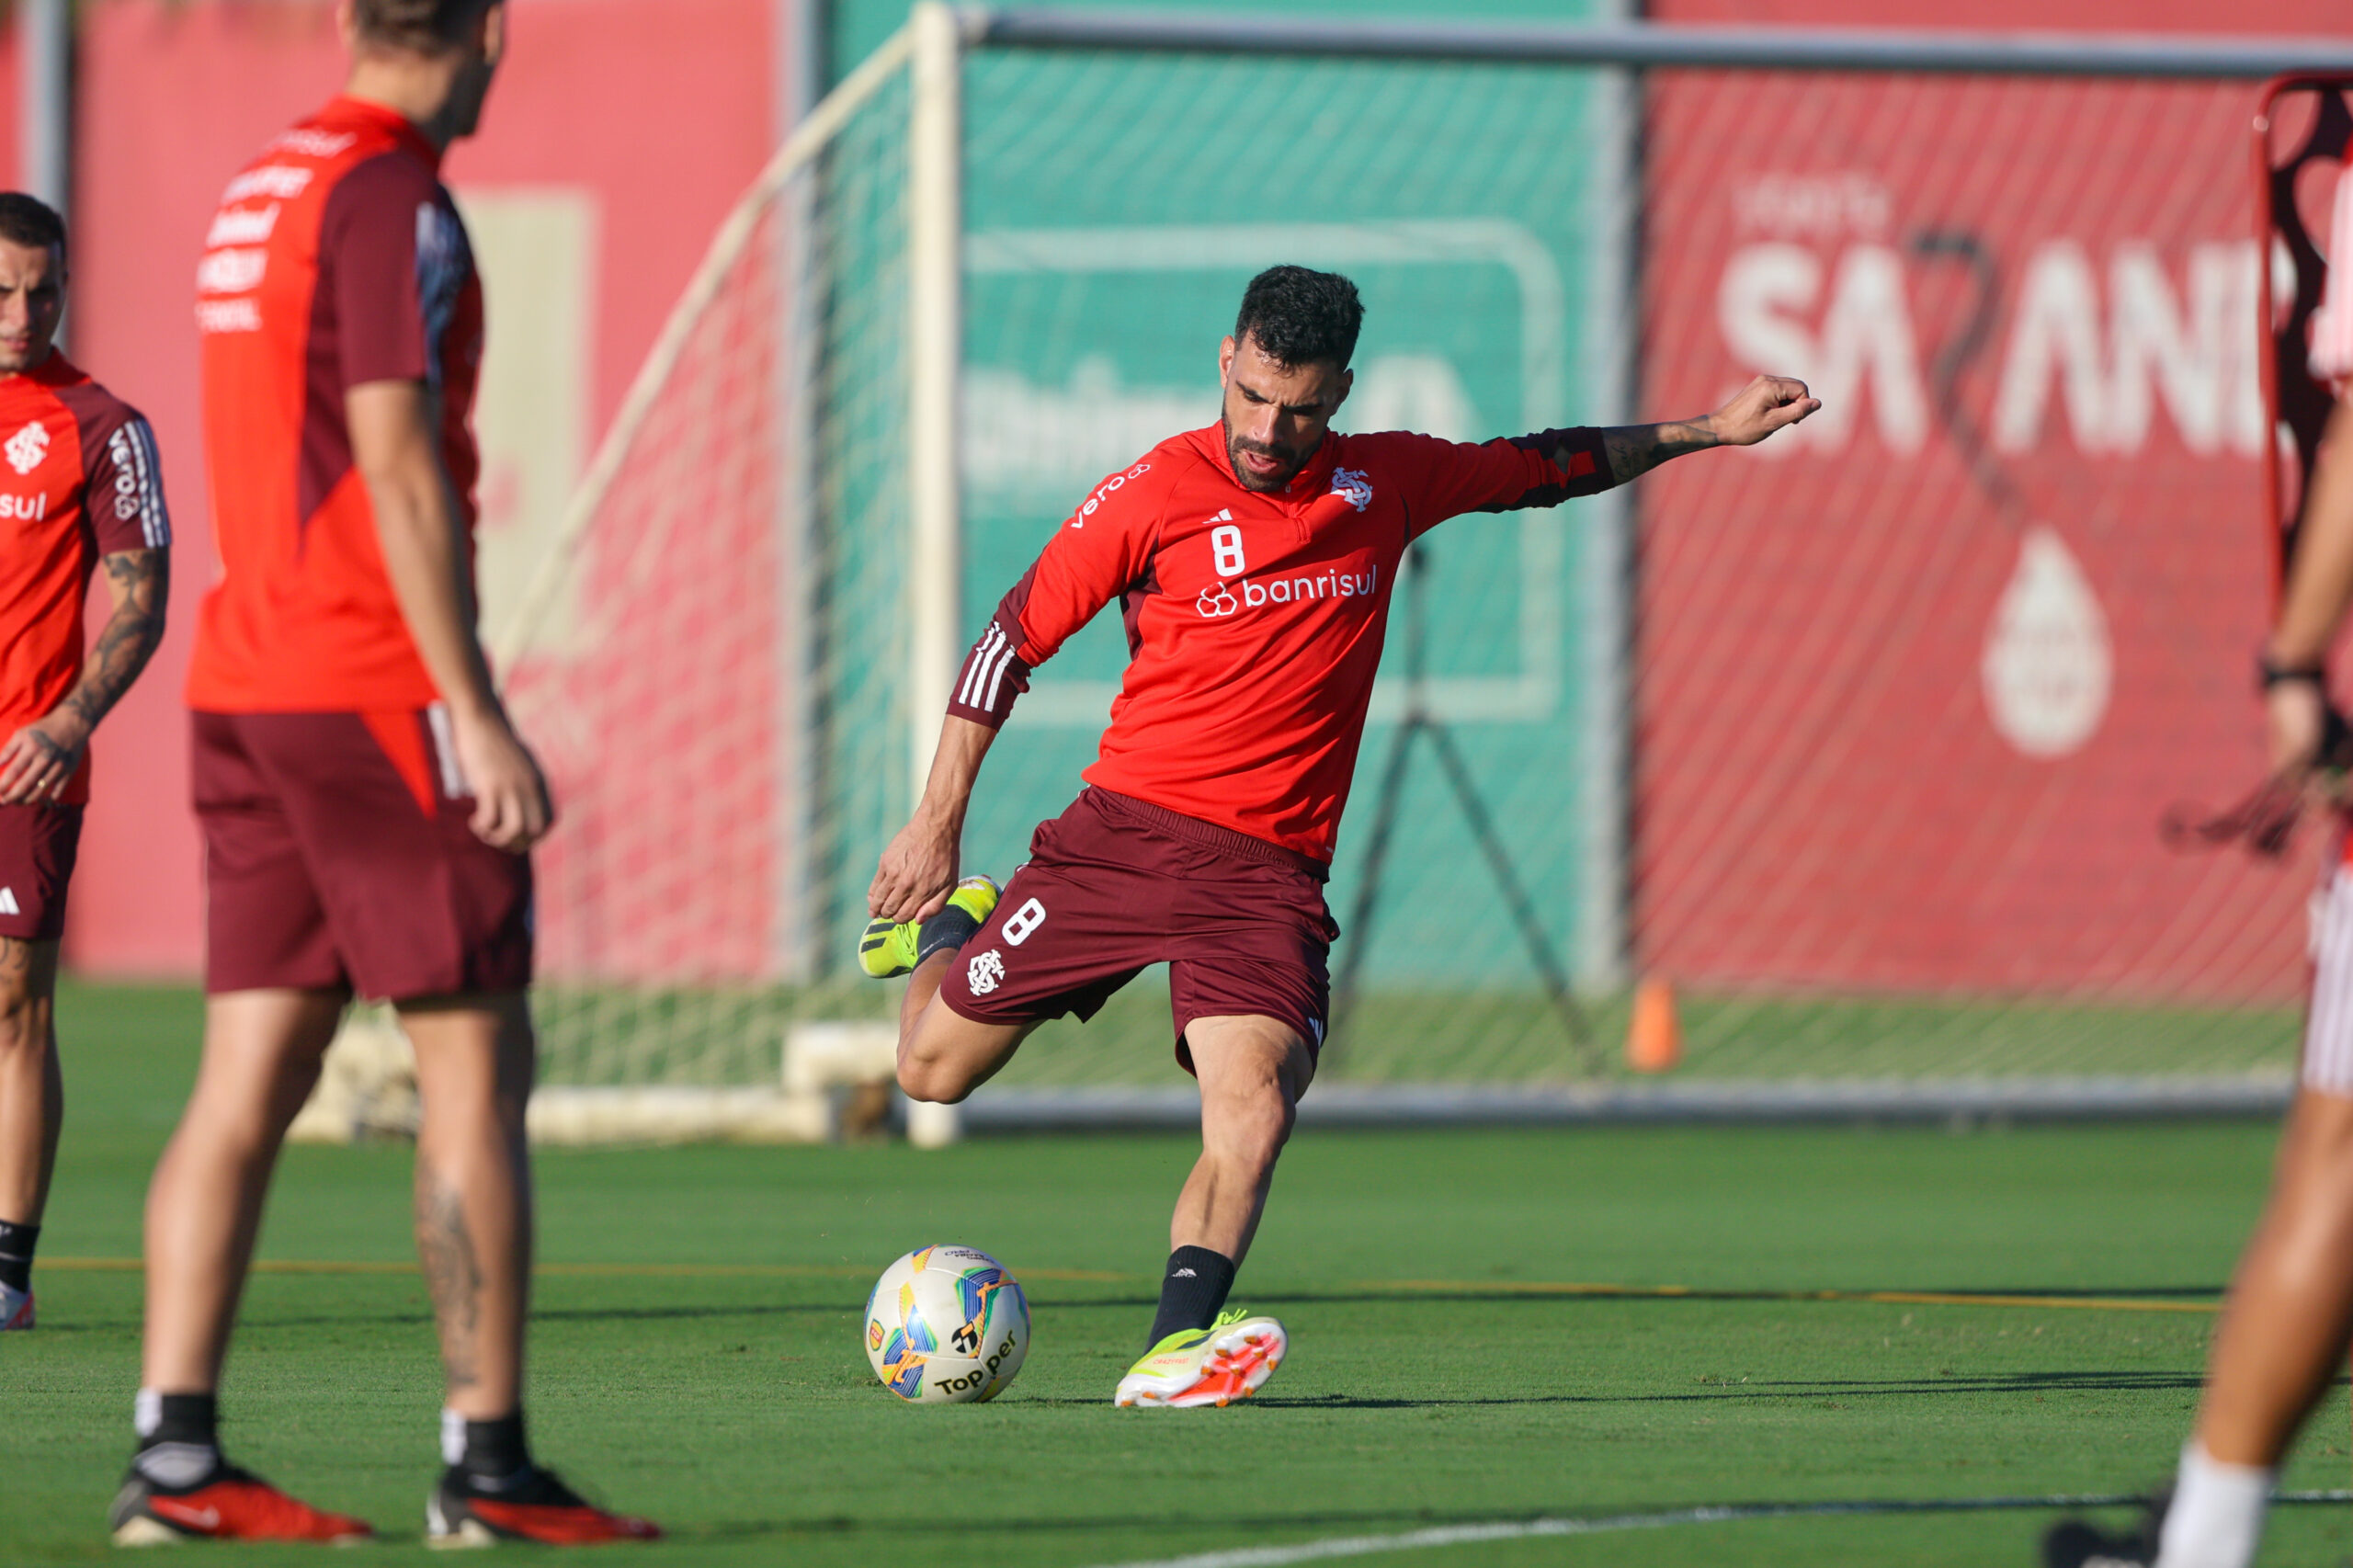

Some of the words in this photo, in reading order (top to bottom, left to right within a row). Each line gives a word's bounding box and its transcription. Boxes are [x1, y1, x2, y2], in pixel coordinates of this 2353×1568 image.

[1071, 475, 1126, 530] vero
[1211, 525, 1245, 577] 8
[1242, 563, 1377, 608] banrisul
[1001, 897, 1047, 947] 8
